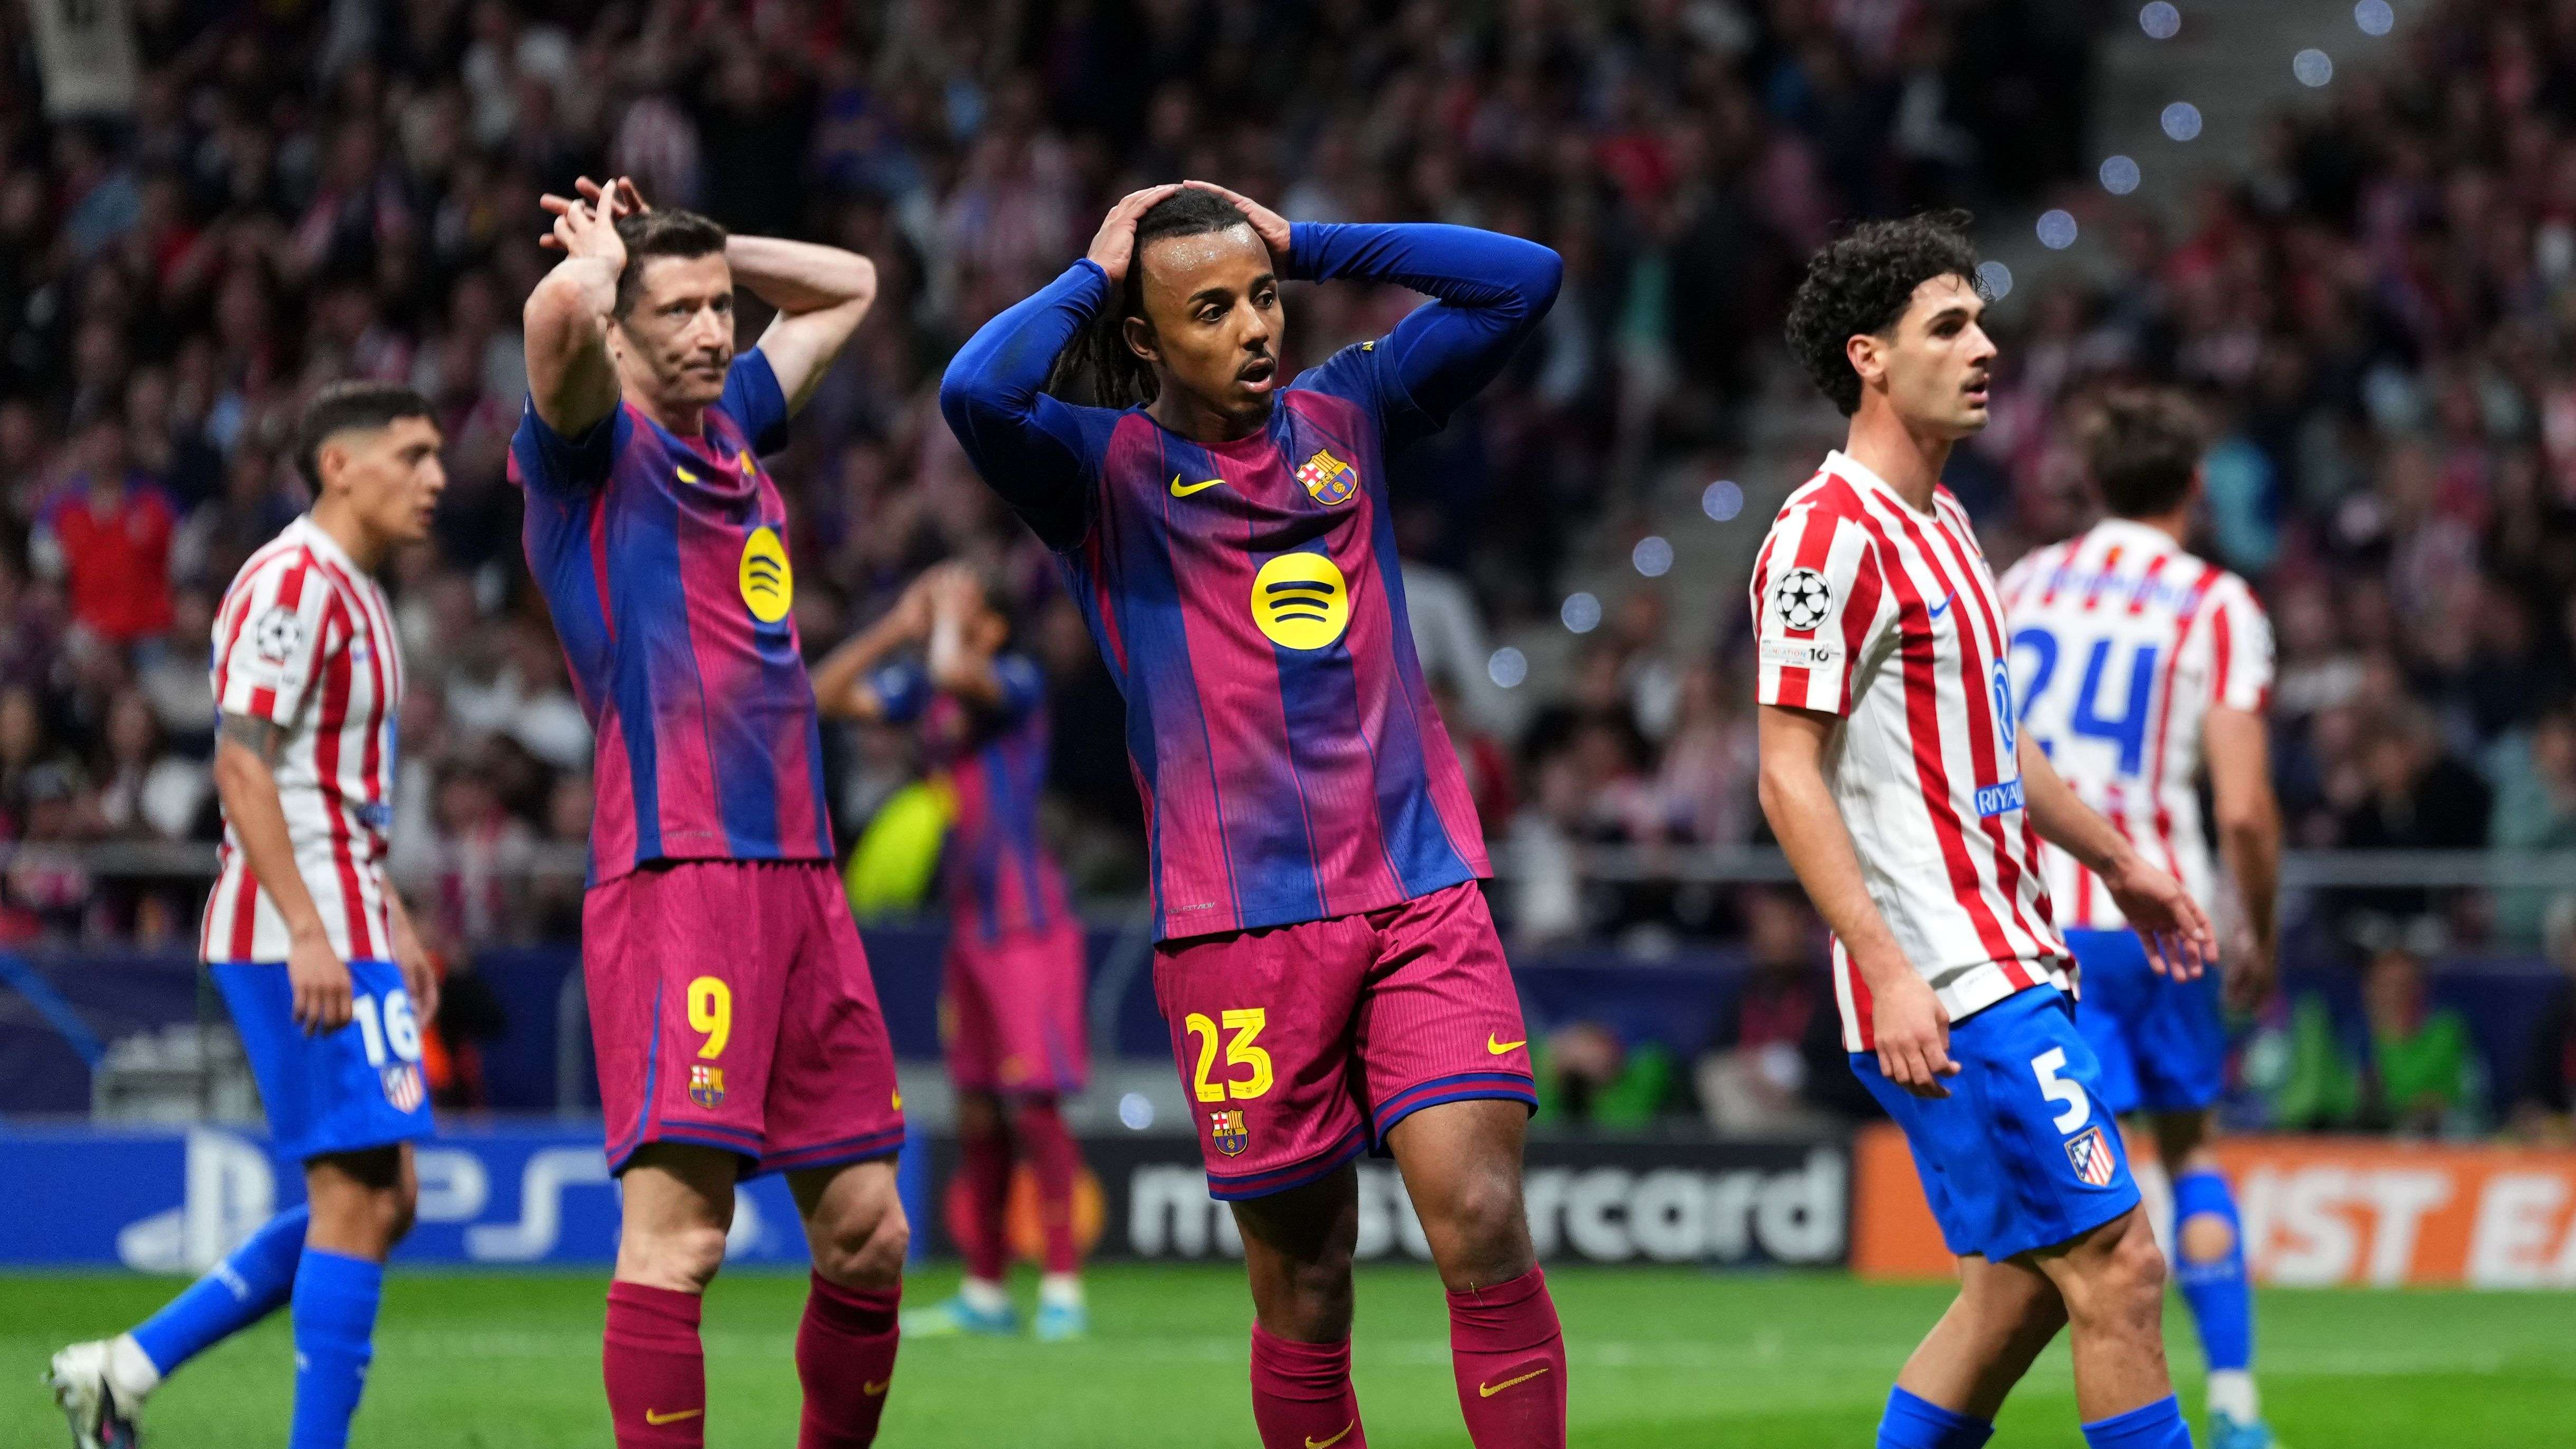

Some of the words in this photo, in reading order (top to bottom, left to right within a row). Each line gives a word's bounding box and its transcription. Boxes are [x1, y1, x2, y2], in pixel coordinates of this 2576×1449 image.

[1809, 648, 1829, 662] 10
[2007, 628, 2157, 777] 24
[352, 990, 421, 1067] 16
[687, 975, 731, 1060] 9
[1185, 1007, 1274, 1103] 23
[2030, 1046, 2091, 1135] 5
